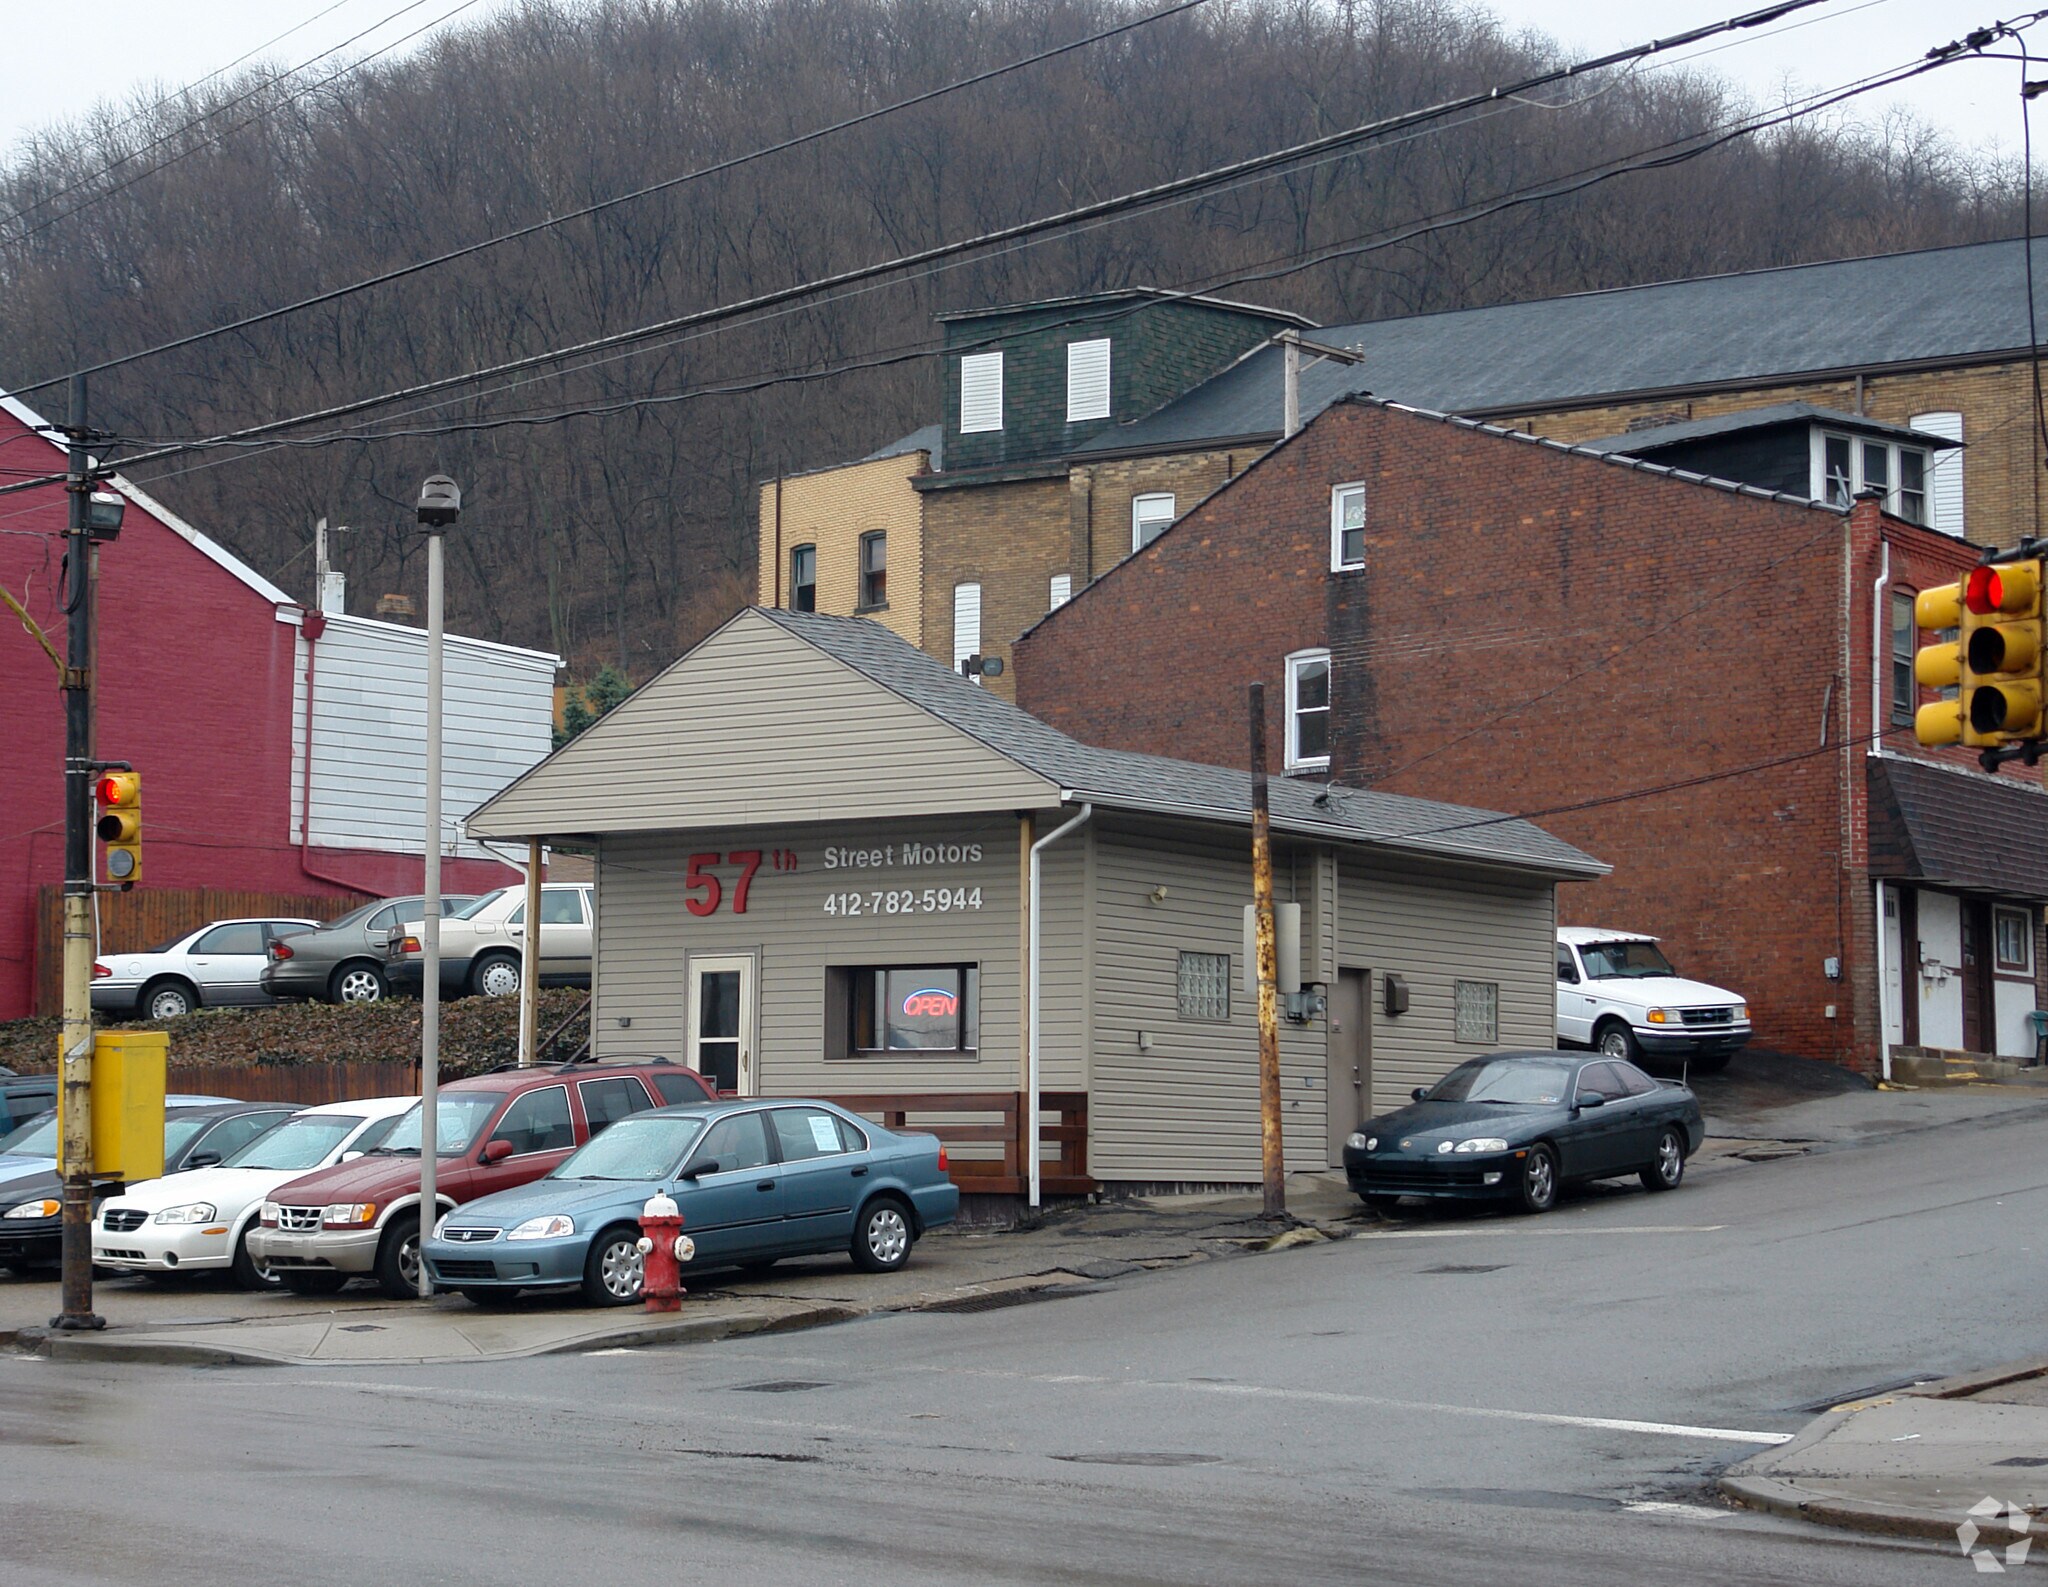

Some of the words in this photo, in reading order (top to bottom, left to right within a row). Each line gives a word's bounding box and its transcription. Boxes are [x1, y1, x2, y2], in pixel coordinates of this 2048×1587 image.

[823, 844, 894, 870] Street
[902, 842, 983, 866] Motors
[823, 887, 983, 916] 412-782-5944
[906, 996, 958, 1017] OPEN
